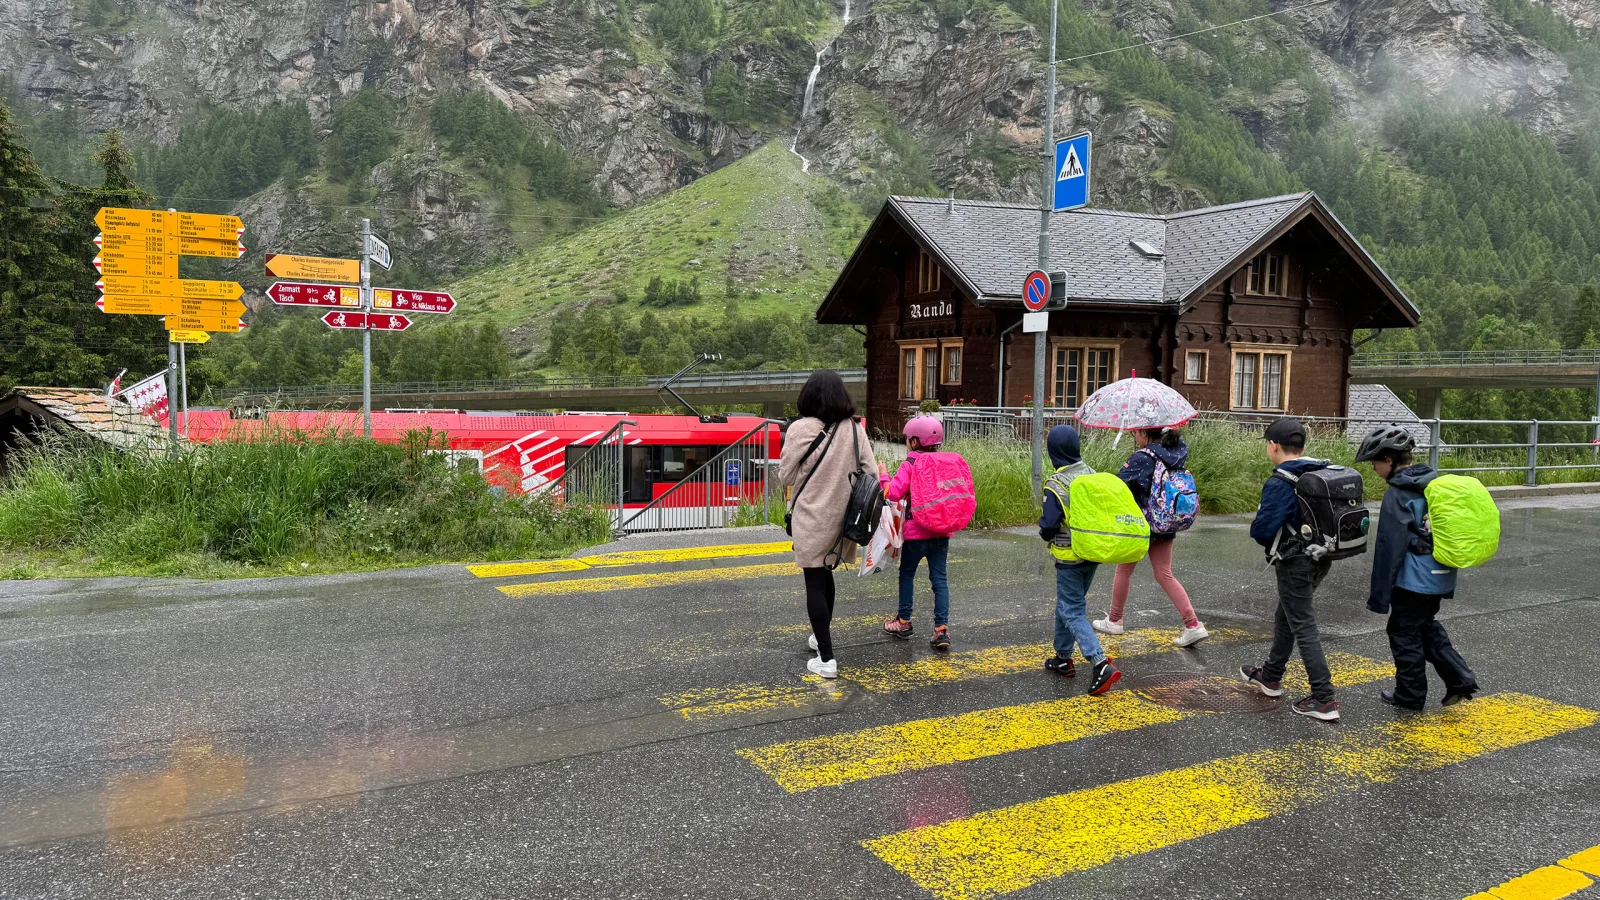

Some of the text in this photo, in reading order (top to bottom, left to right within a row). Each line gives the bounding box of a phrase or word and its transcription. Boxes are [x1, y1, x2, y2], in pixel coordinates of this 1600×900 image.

[279, 285, 300, 293] Zermatt
[279, 294, 294, 302] Täsch
[342, 296, 359, 304] 150
[412, 293, 422, 302] Visp
[376, 298, 392, 306] 150
[910, 300, 952, 318] Randa
